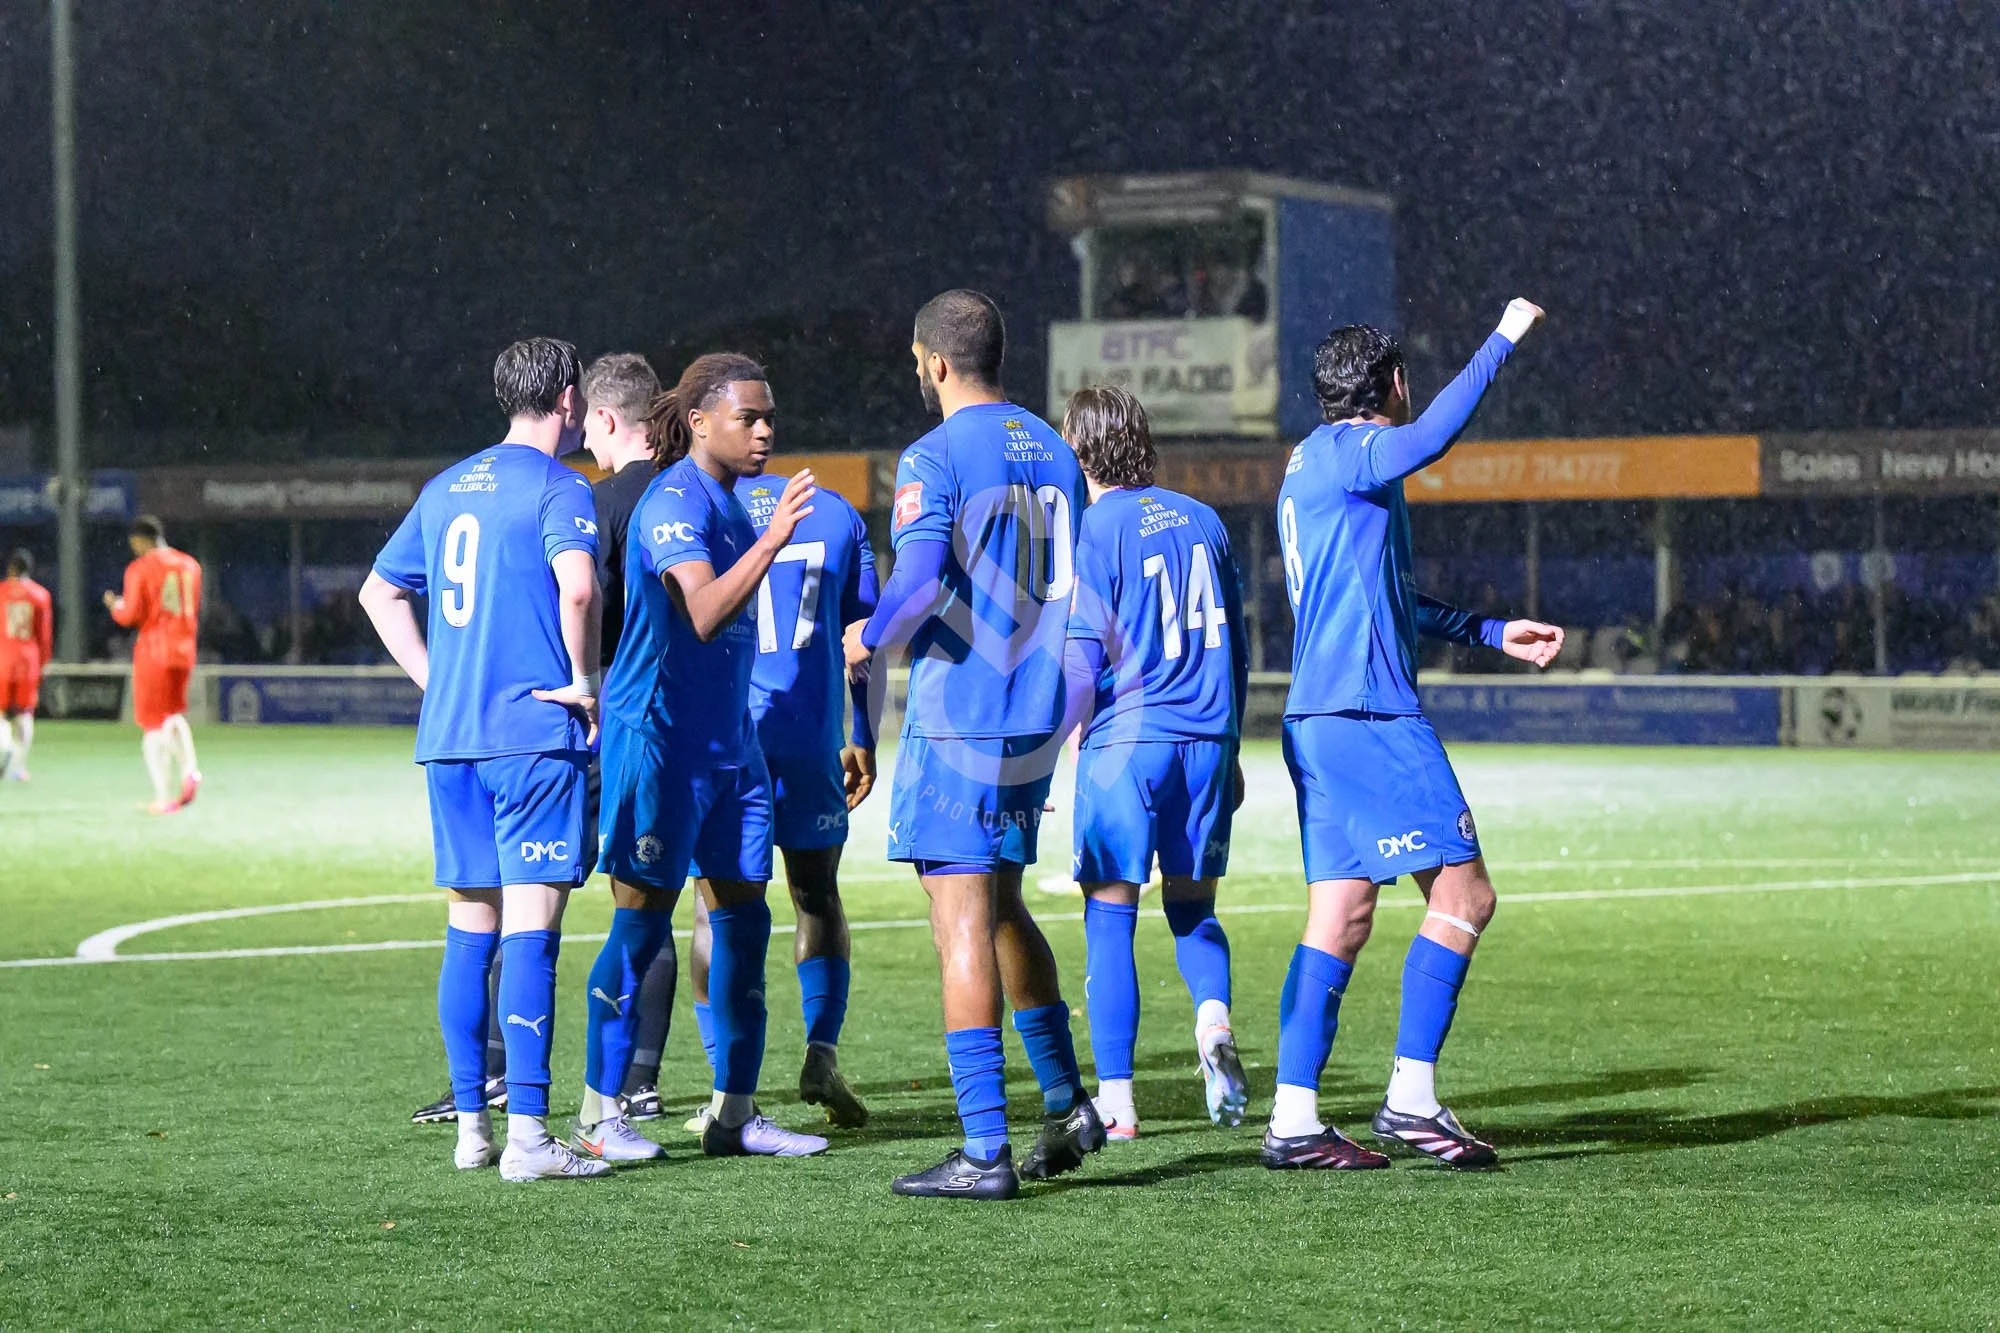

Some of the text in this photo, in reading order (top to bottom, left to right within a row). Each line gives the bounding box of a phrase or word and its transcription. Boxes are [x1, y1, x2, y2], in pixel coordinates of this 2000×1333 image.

[1007, 430, 1033, 441] THE
[1005, 440, 1044, 451] CROWN
[1003, 451, 1054, 462] BILLERICAY
[472, 463, 492, 473] THE
[449, 482, 498, 492] BILLERICAY
[459, 473, 496, 484] CROWN
[751, 497, 778, 507] THE
[1142, 503, 1166, 515] THE
[1141, 509, 1179, 527] CROWN
[652, 521, 694, 545] DMC
[1011, 483, 1074, 602] 10
[441, 513, 480, 628] 9
[160, 570, 196, 617] 41
[757, 540, 826, 654] 17
[1143, 543, 1227, 661] 14
[521, 840, 569, 863] DMC
[1376, 830, 1427, 858] DMC
